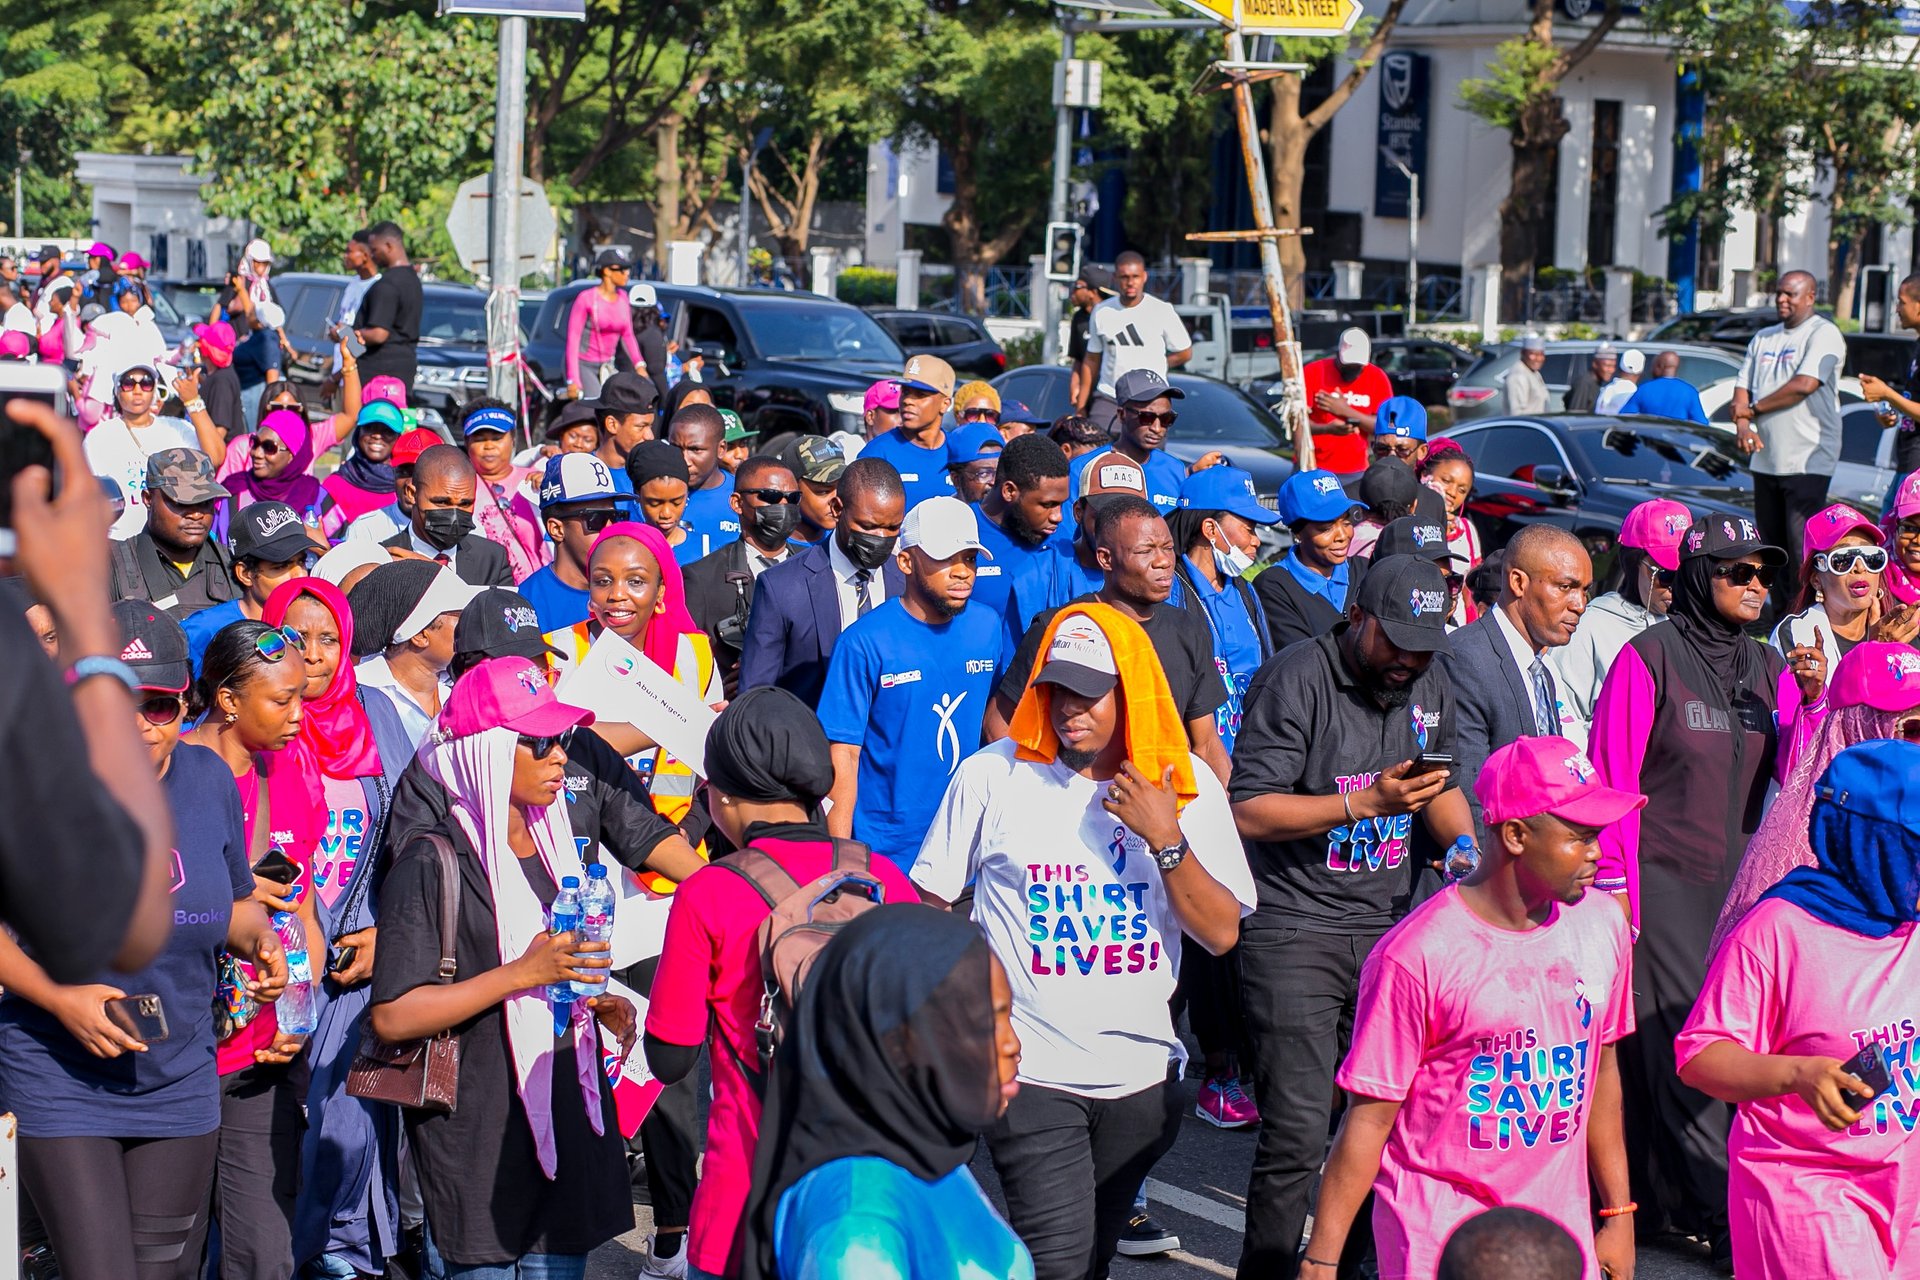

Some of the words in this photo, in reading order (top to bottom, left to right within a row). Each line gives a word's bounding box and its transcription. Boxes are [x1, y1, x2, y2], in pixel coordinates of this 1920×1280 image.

[1243, 0, 1294, 16] MADEIRA
[1298, 0, 1340, 16] STREET
[590, 462, 609, 487] B
[121, 651, 152, 660] adidas
[660, 699, 687, 724] Nigeria
[1027, 864, 1089, 882] THIS
[1028, 882, 1149, 914] SHIRT
[174, 908, 225, 925] Books
[1029, 913, 1148, 943] SAVES
[1031, 941, 1160, 976] LIVES!
[1475, 1028, 1537, 1054] THIS
[1851, 1019, 1916, 1051] THIS
[1469, 1039, 1590, 1083] SHIRT
